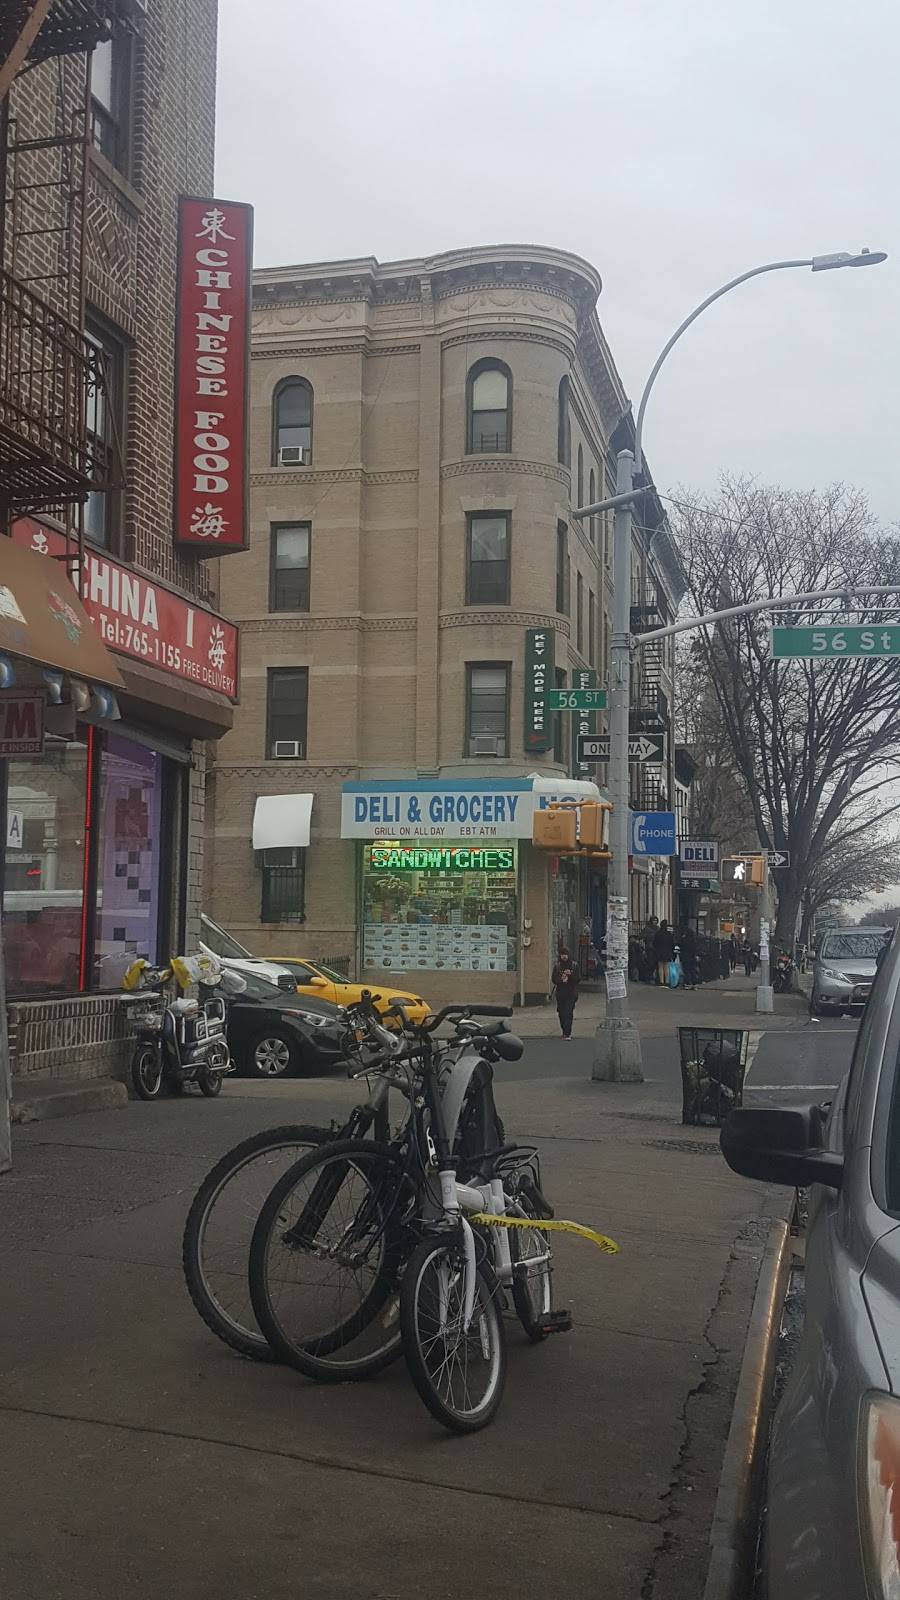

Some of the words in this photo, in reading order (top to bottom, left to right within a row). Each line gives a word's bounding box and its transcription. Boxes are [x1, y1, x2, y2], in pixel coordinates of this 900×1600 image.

[195, 207, 236, 244] 東
[195, 248, 233, 397] CHINESE
[192, 410, 230, 494] FOOD
[189, 502, 230, 539] 海
[100, 613, 181, 670] Tel:765-1155
[208, 623, 228, 671] 海
[534, 634, 546, 655] KEY
[811, 632, 847, 651] 56
[860, 631, 892, 650] St
[182, 658, 201, 680] FREE
[202, 667, 235, 692] DELIVERY
[533, 664, 546, 692] MADE
[559, 692, 577, 708] 56
[585, 691, 600, 703] ST
[533, 701, 545, 730] HERE
[354, 796, 400, 823] DELI
[407, 795, 422, 823] &
[429, 795, 519, 823] GROCERY
[10, 815, 20, 837] A
[374, 827, 396, 836] GRILL
[400, 827, 410, 836] ON
[414, 827, 428, 836] ALL
[430, 827, 445, 836] DAY
[460, 827, 476, 836] EBT
[479, 827, 497, 836] ATM
[640, 829, 674, 838] PHONE
[373, 849, 513, 868] SANDWICHES
[684, 847, 714, 860] DELI
